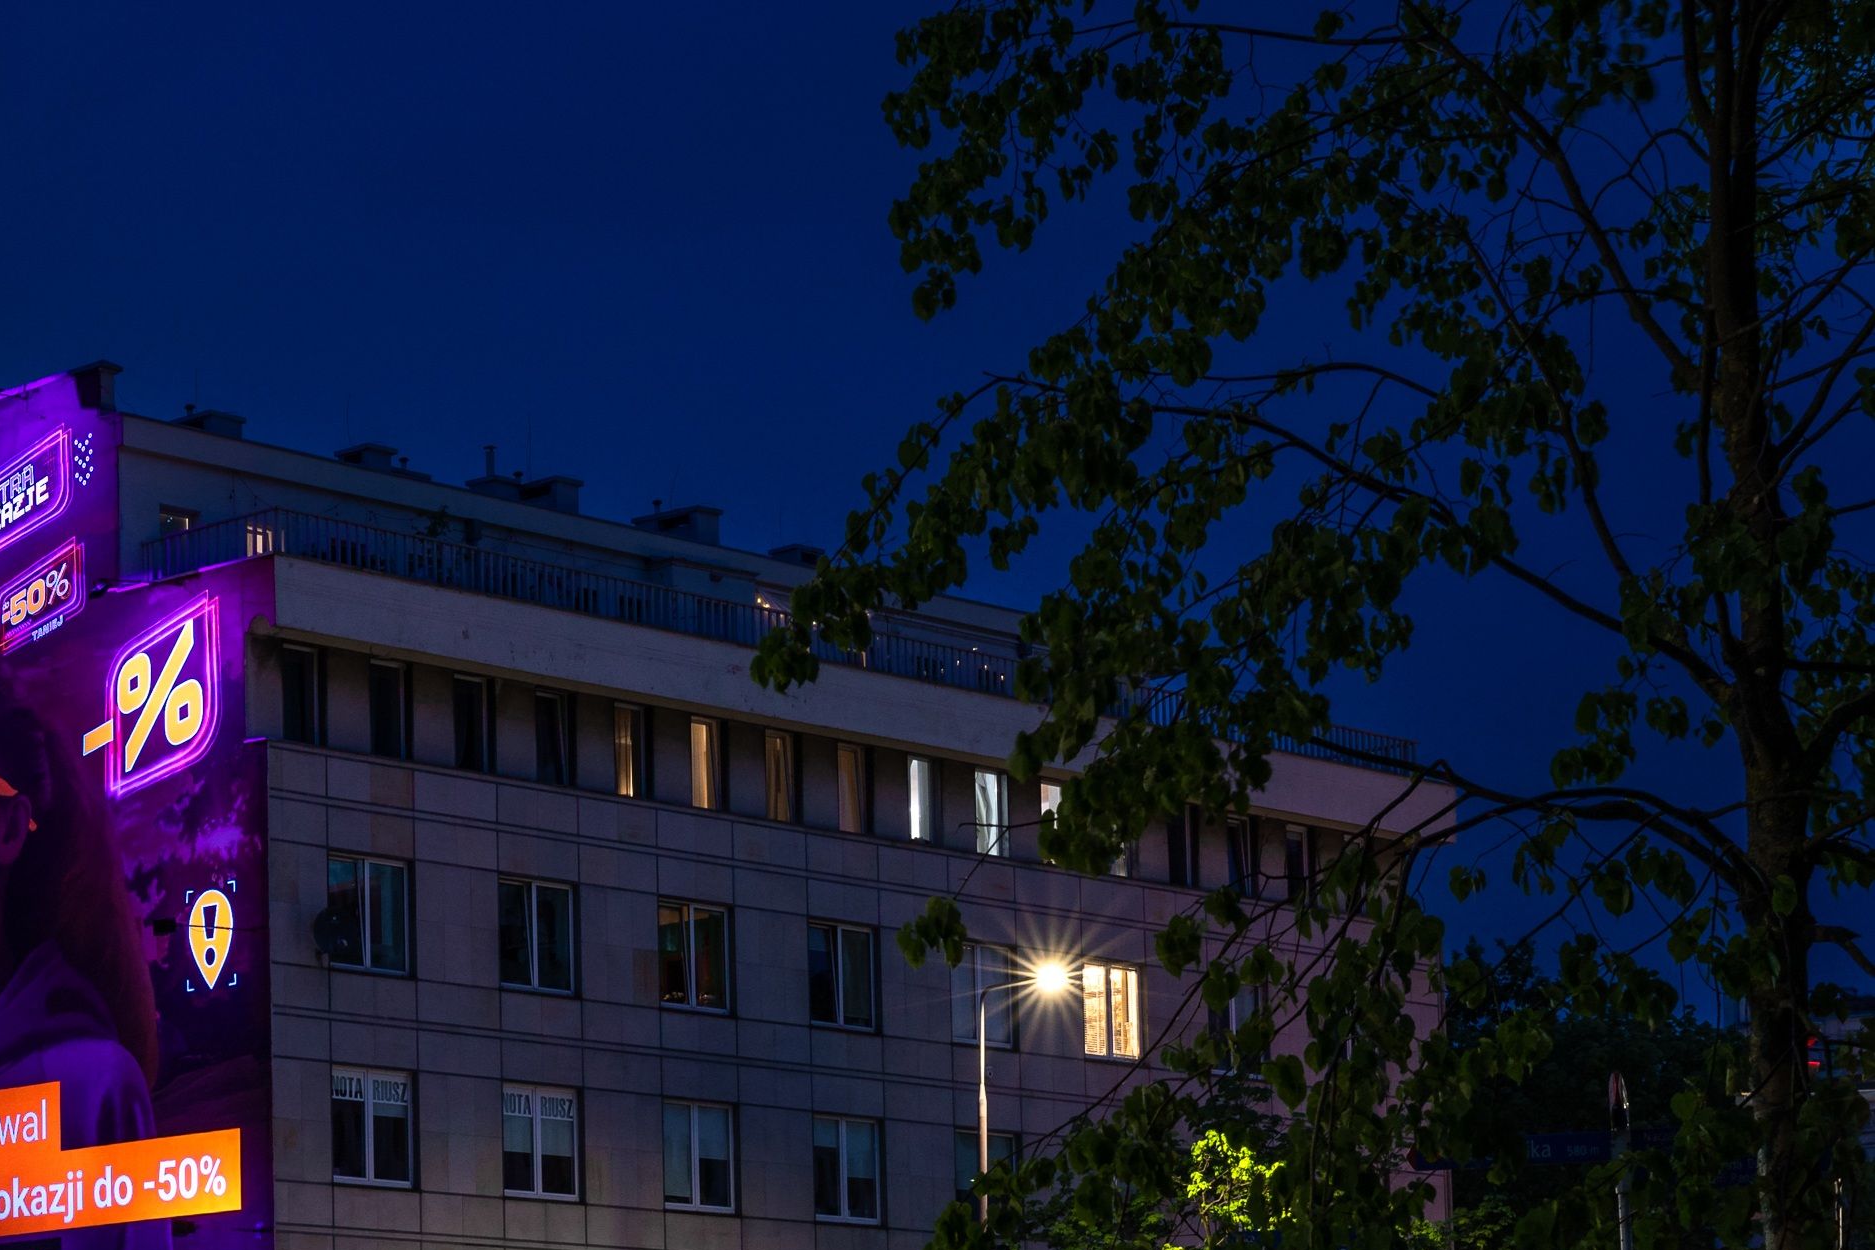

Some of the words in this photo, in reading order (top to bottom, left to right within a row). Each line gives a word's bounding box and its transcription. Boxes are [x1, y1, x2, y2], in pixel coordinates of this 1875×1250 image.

[1, 563, 69, 626] -50%
[32, 614, 64, 642] TANIEJ
[94, 1163, 133, 1206] do
[143, 1154, 227, 1202] -50%
